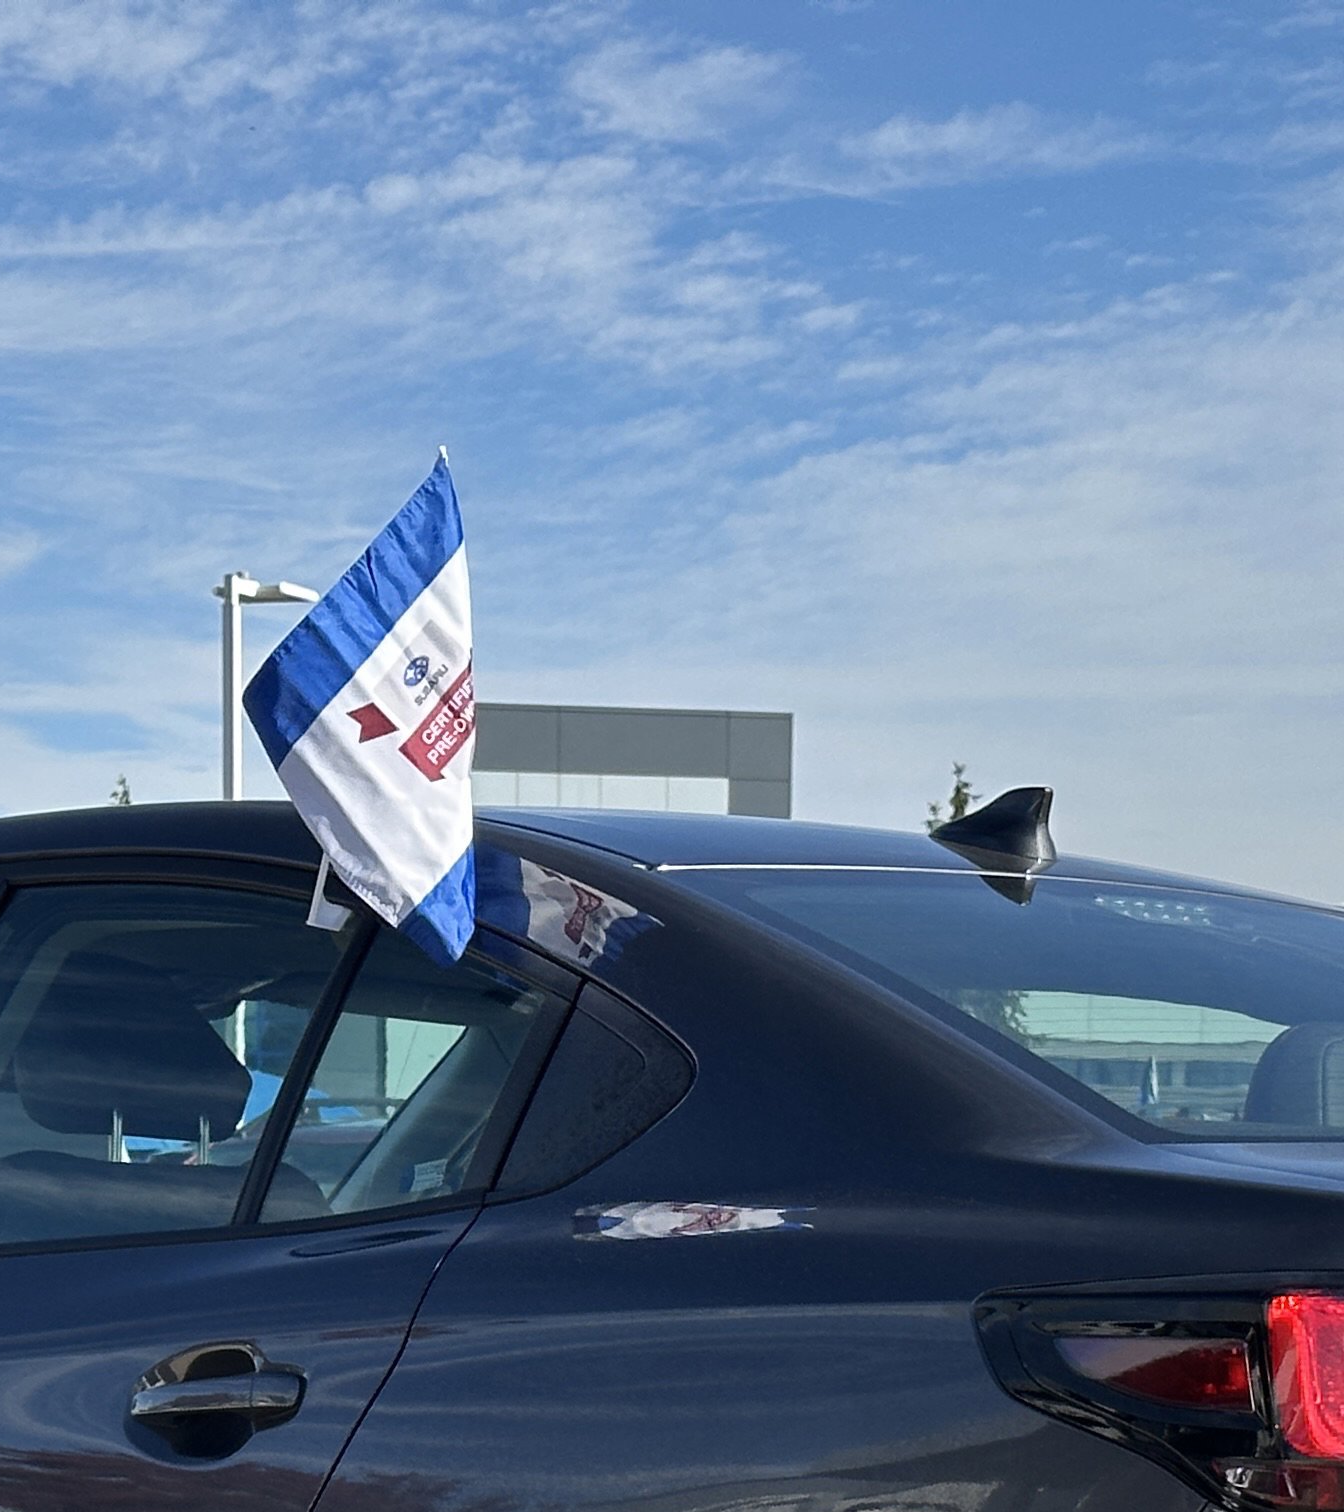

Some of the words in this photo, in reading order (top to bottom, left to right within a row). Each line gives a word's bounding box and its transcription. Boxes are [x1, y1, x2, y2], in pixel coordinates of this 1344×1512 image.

[414, 664, 449, 706] SUBARU
[422, 676, 472, 745] CERTIFIE
[426, 700, 475, 765] PRE-OW
